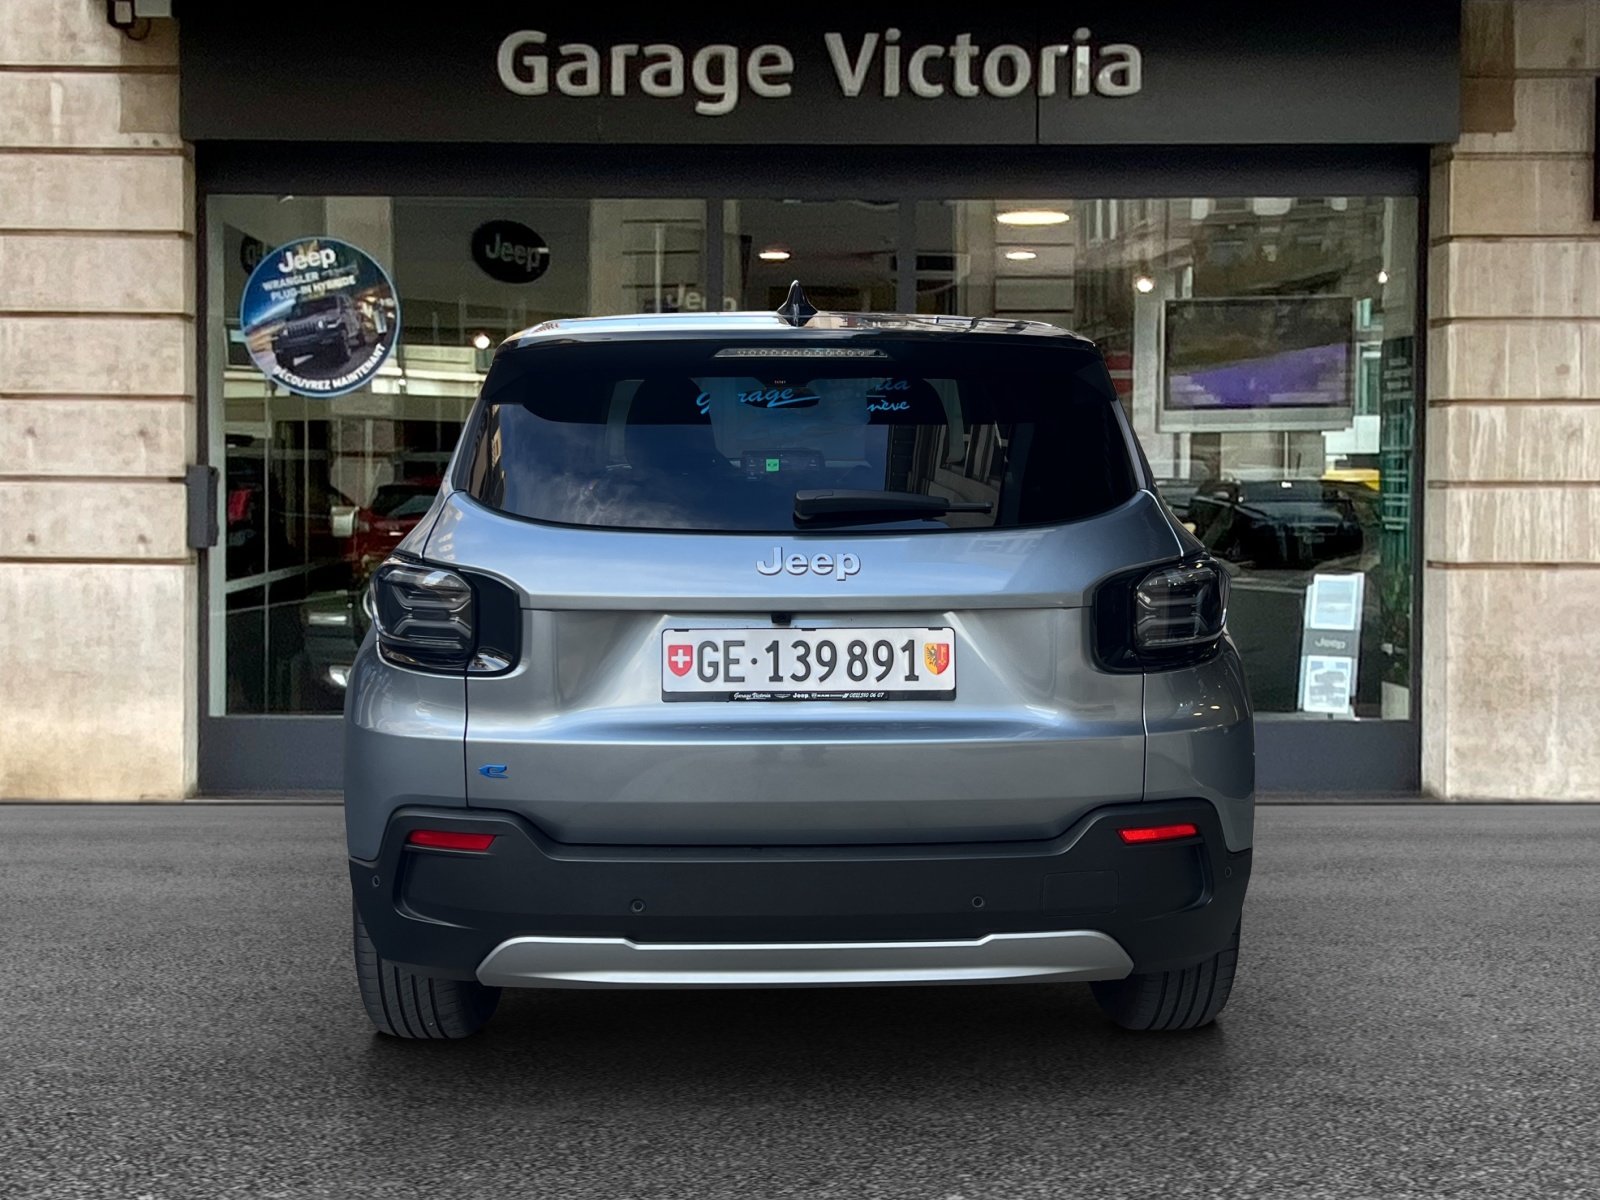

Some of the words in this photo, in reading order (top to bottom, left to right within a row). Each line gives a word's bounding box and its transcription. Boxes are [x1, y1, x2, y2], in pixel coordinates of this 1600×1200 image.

[497, 29, 795, 116] Garage
[824, 27, 1143, 98] Victoria
[277, 248, 337, 273] Jeep
[485, 232, 541, 273] Jeep
[262, 271, 320, 292] WRANGLER
[665, 287, 737, 312] Jep
[331, 343, 386, 389] MAINTENANT
[756, 546, 862, 581] Jeep
[1314, 637, 1347, 650] Jeep
